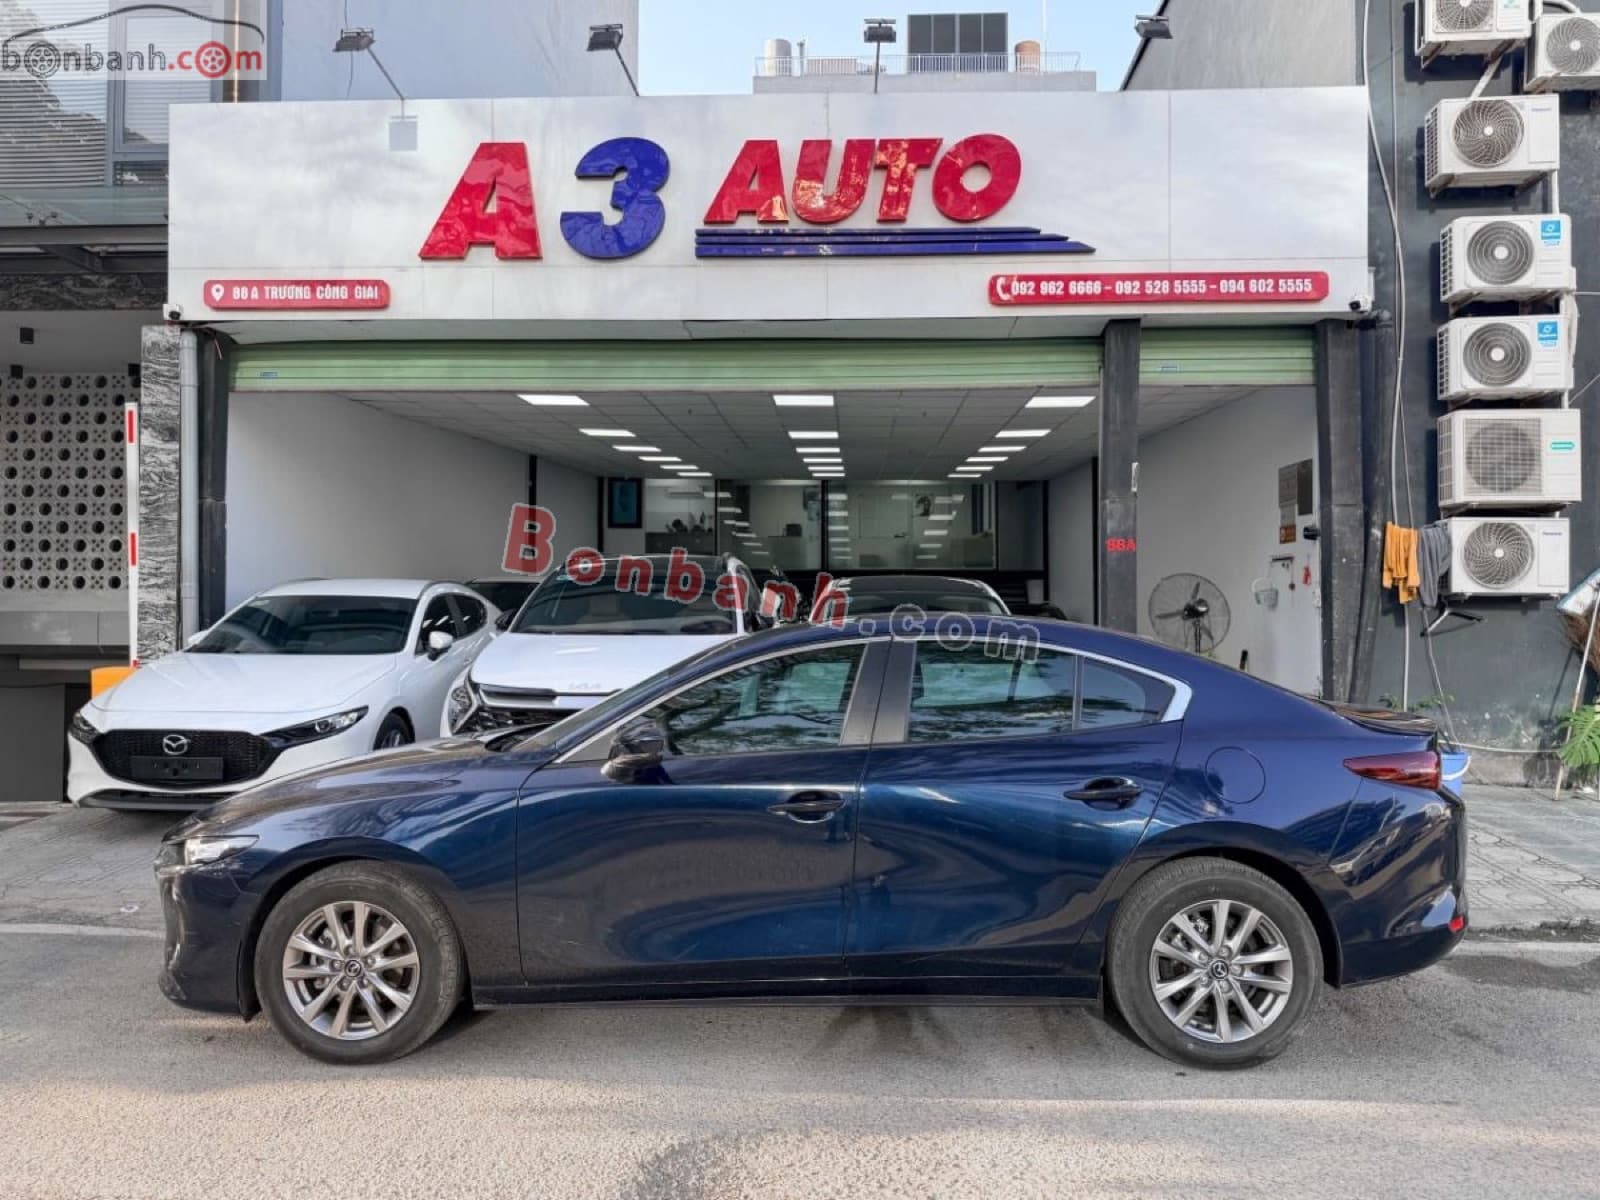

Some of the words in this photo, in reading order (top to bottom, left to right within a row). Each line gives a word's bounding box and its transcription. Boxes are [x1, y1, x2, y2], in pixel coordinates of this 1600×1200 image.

[704, 133, 1022, 223] AUTO
[250, 286, 259, 300] A
[316, 284, 348, 300] CÔNG
[354, 286, 378, 300] GIAI
[1011, 280, 1035, 296] 092
[1039, 280, 1065, 296] 962
[1068, 280, 1102, 295] 6666
[1115, 279, 1141, 295] 092
[1145, 279, 1169, 294] 528
[1174, 279, 1206, 294] 5555
[1219, 278, 1244, 293] 094
[1278, 278, 1312, 293] 5555
